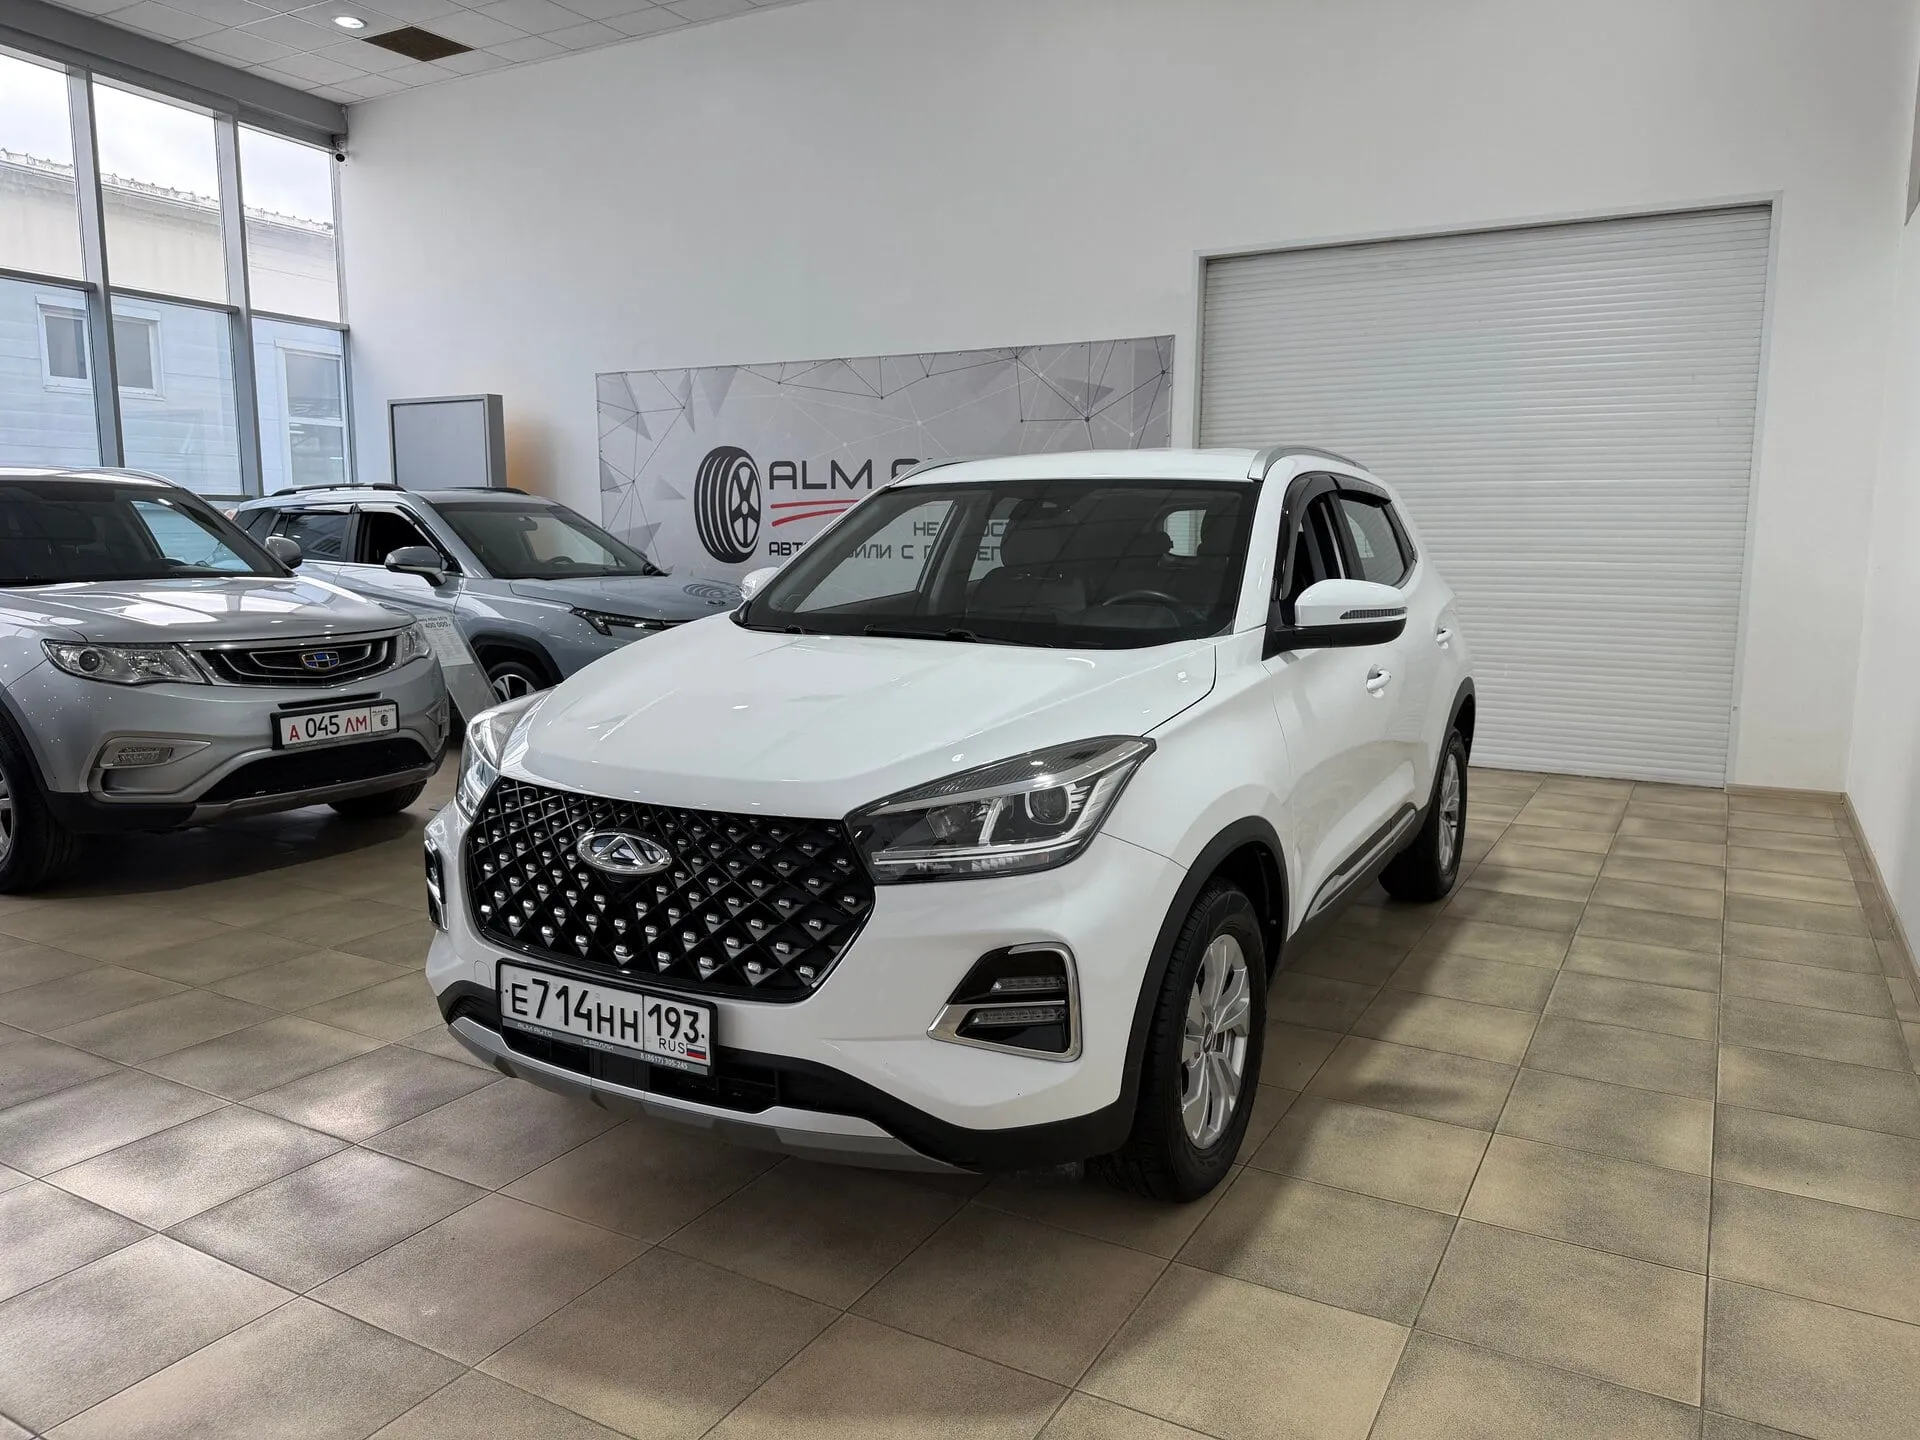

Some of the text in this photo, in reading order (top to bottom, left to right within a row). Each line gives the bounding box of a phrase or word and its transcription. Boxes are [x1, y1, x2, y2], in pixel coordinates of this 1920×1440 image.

[769, 459, 872, 490] ALM
[768, 542, 892, 559] АВТИЛИ
[305, 714, 340, 738] 045
[648, 1004, 700, 1044] 193
[658, 1038, 686, 1054] RUS
